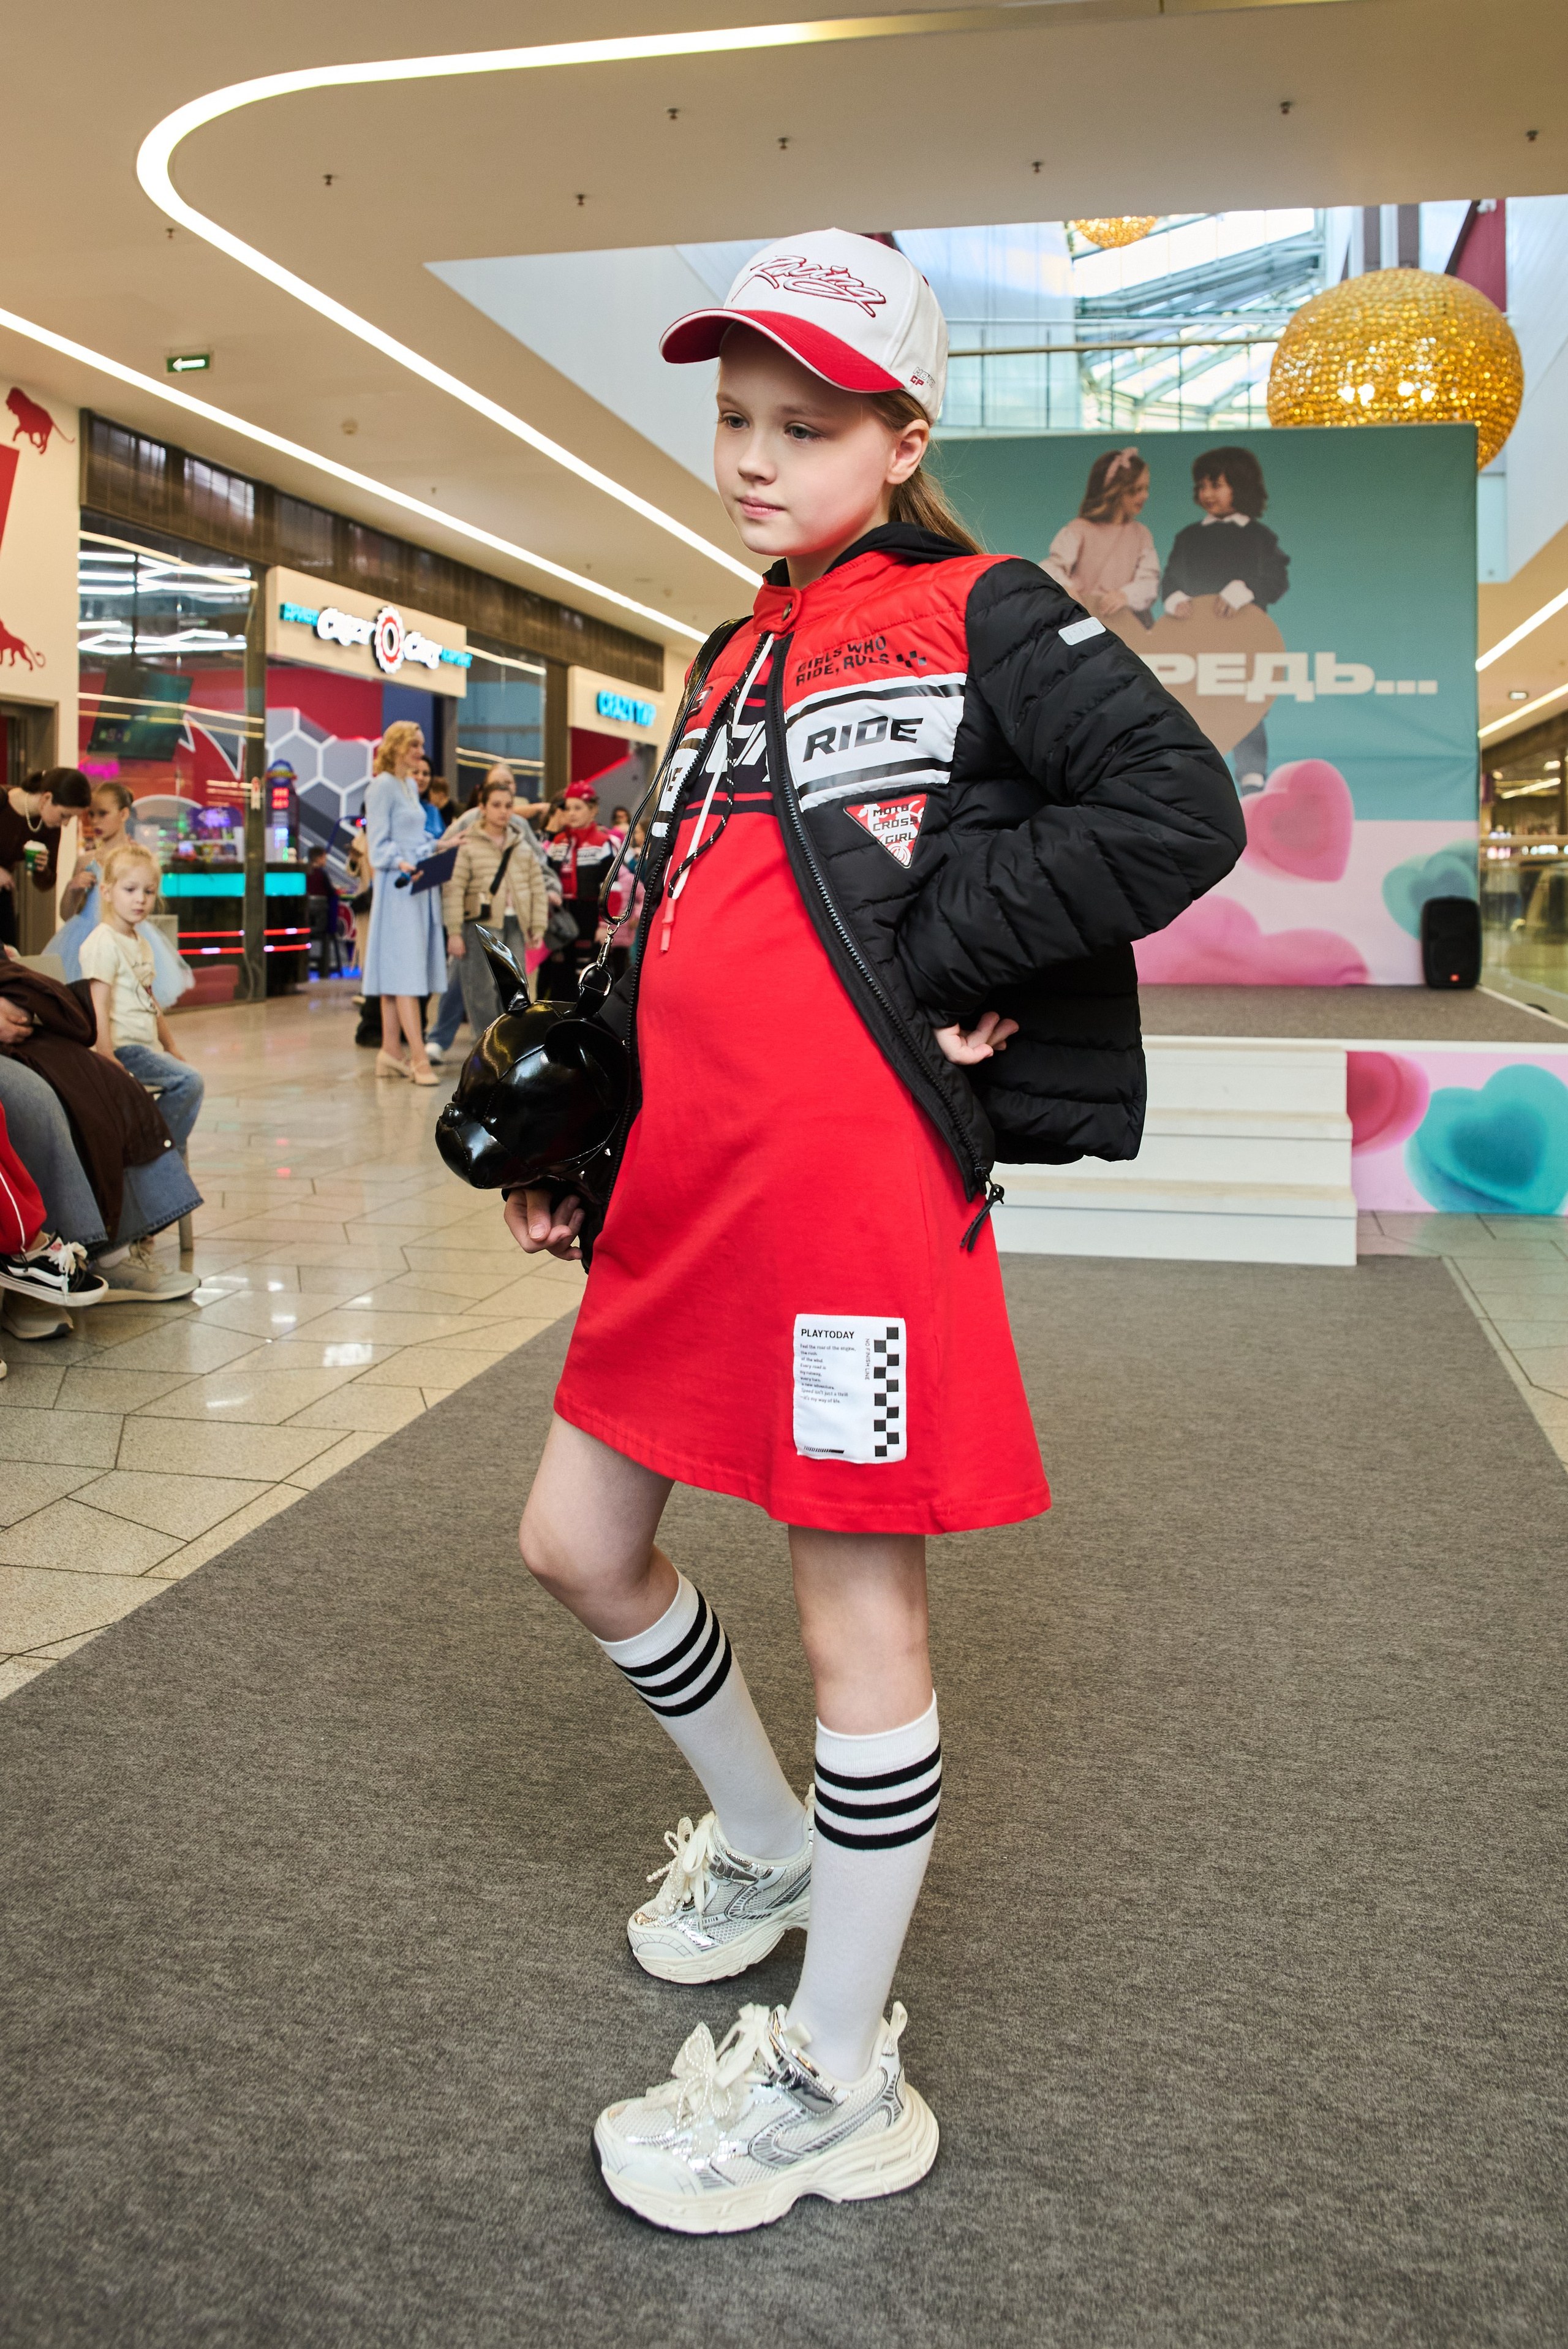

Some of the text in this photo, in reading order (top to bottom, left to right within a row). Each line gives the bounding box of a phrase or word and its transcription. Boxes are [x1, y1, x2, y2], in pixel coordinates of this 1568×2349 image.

[731, 255, 887, 318] Racing
[910, 375, 924, 386] GP
[797, 635, 887, 673] GIRLS WHO
[796, 662, 840, 686] RIDE,
[802, 716, 924, 763] RIDE
[873, 804, 909, 817] MOTO
[872, 817, 918, 831] CROSS
[884, 832, 916, 844] GIRL
[801, 1328, 854, 1339] PLAYTODAY
[865, 1338, 870, 1347] NO
